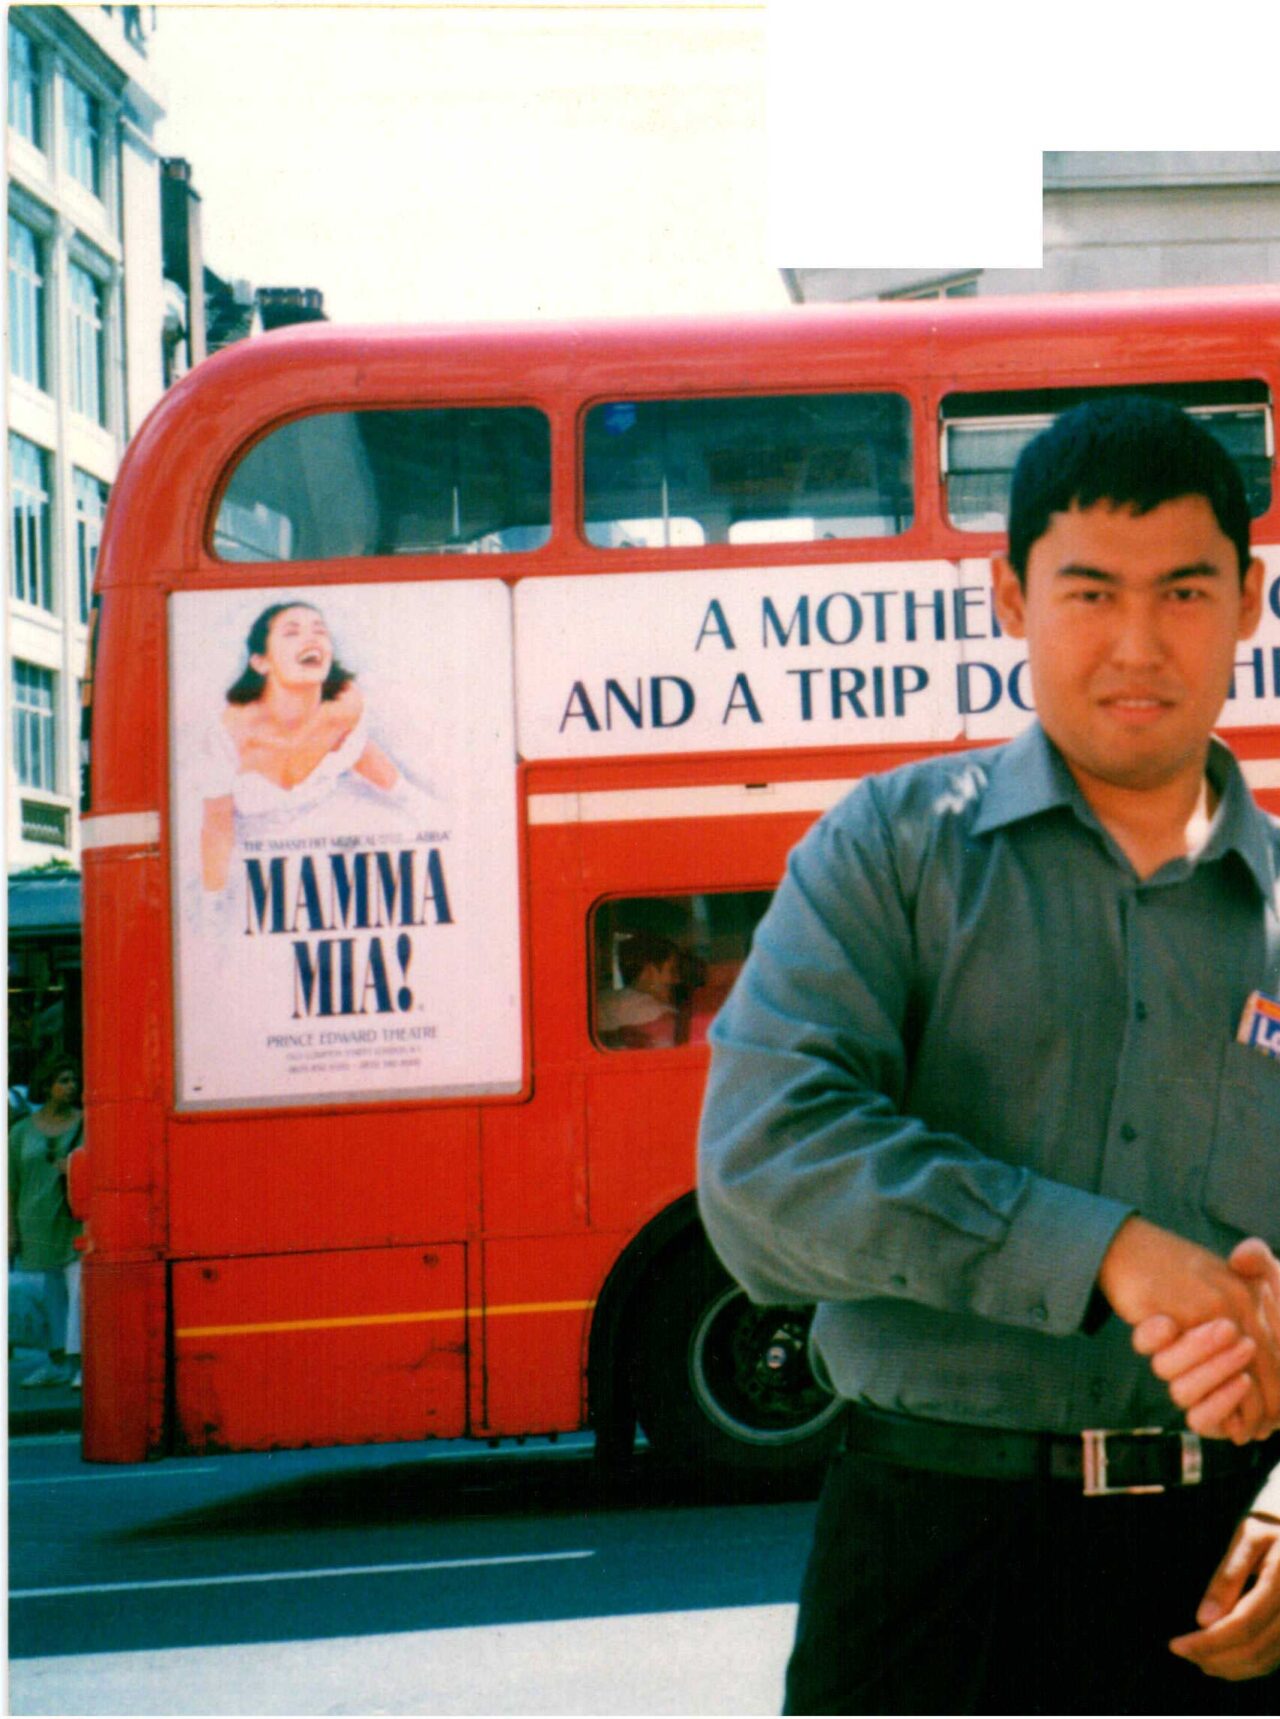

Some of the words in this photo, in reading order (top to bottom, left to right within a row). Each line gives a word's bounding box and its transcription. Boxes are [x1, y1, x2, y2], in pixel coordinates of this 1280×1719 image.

[694, 598, 736, 652] A
[558, 674, 696, 734] AND
[722, 671, 764, 725] A
[786, 664, 930, 721] TRIP
[956, 659, 1036, 715] DO
[243, 848, 455, 936] MAMMA
[291, 932, 414, 1019] MIA!
[266, 1033, 313, 1048] PRINCE
[319, 1028, 378, 1046] EDWARD
[382, 1025, 437, 1042] THEATRE
